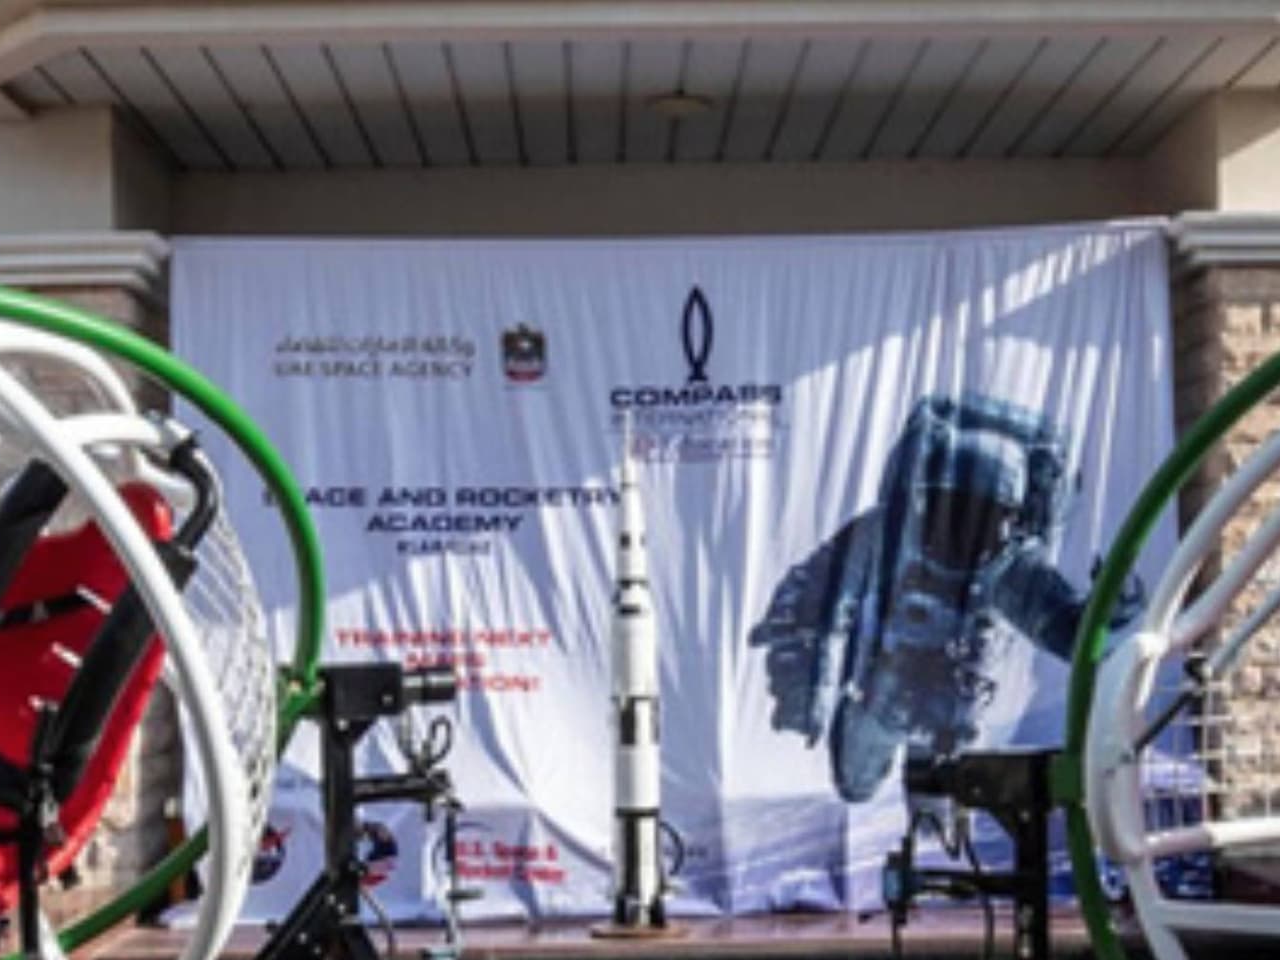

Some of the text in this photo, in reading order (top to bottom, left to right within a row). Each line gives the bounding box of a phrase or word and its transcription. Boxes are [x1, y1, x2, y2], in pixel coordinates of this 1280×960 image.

[320, 360, 382, 377] SPACE
[390, 360, 472, 377] AGENCY
[610, 386, 783, 407] COMPASS
[377, 486, 446, 507] AND
[455, 486, 621, 507] ROCKETRY
[367, 514, 523, 532] ACADEMY
